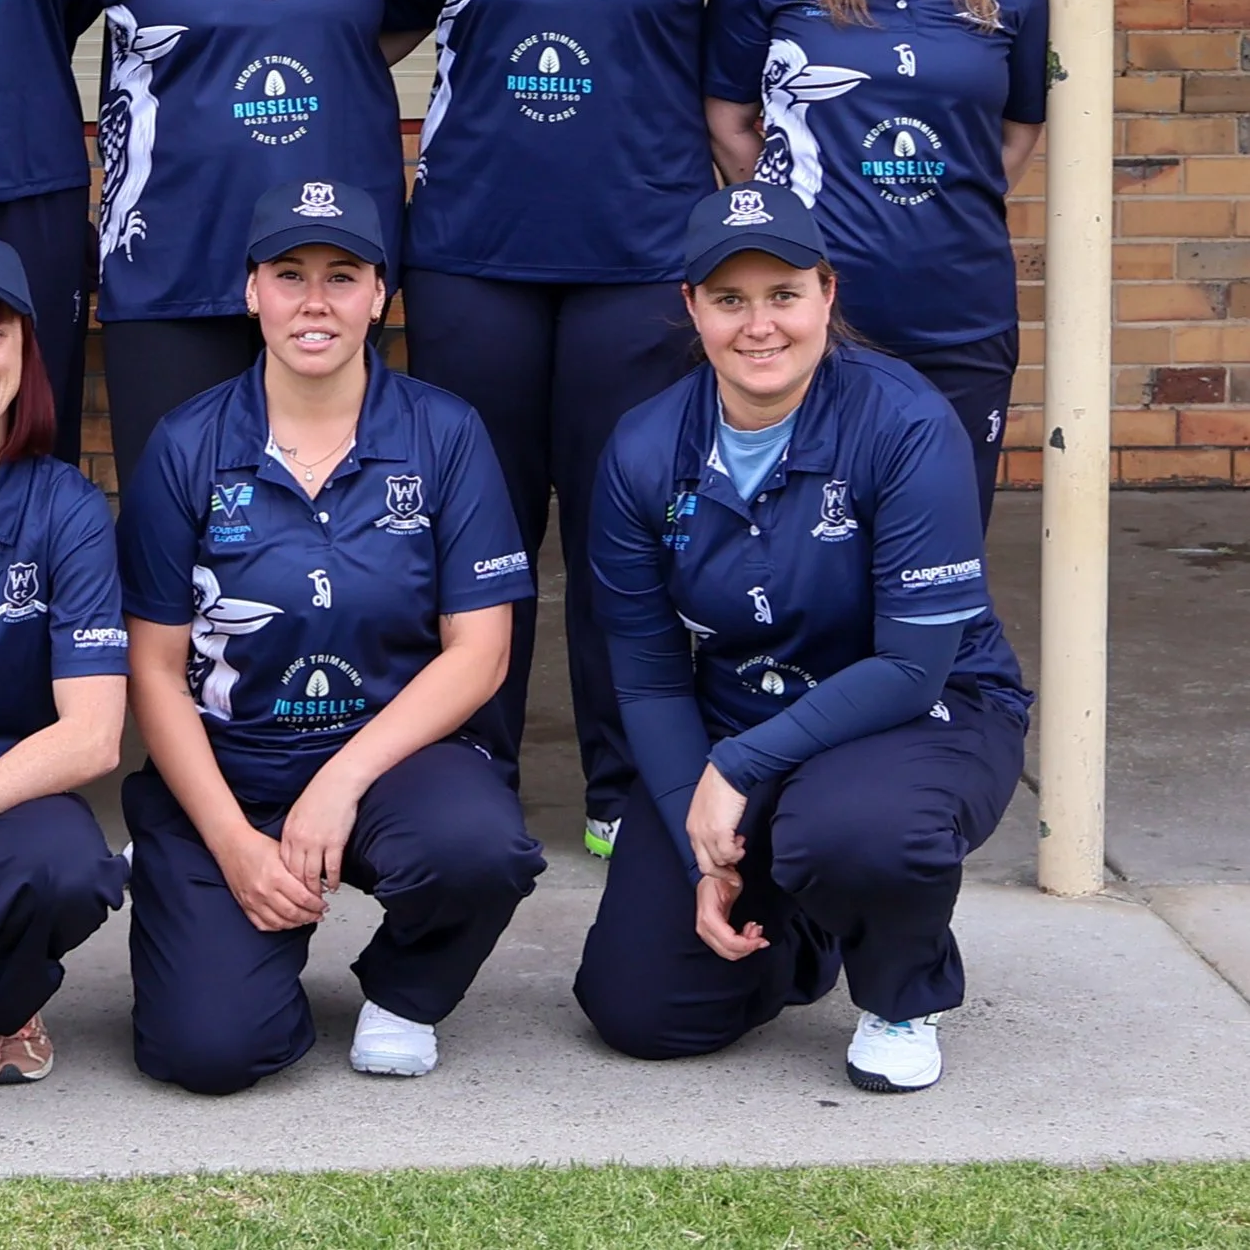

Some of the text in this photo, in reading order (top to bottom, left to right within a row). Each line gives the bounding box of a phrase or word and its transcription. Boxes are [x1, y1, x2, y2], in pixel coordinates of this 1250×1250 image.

[510, 32, 590, 66] HEDGE TRIMMING
[233, 55, 314, 91] HEDGE TRIMMING
[507, 75, 593, 94] RUSSELL'S
[514, 91, 538, 100] 0432
[540, 91, 558, 101] 671
[232, 96, 319, 119] RUSSELL'S
[519, 104, 577, 123] TREE CARE
[244, 116, 269, 126] 0432
[270, 114, 289, 124] 671
[250, 126, 308, 145] TREE CARE
[862, 116, 942, 150] HEDGE TRIMMING
[872, 177, 897, 185] 0432
[899, 177, 918, 185] 671
[879, 188, 936, 206] TREE CARE
[396, 502, 413, 511] CC
[209, 525, 252, 535] SOUTHERN
[12, 589, 28, 600] CC
[280, 654, 363, 688] HEDGE TRIMMING
